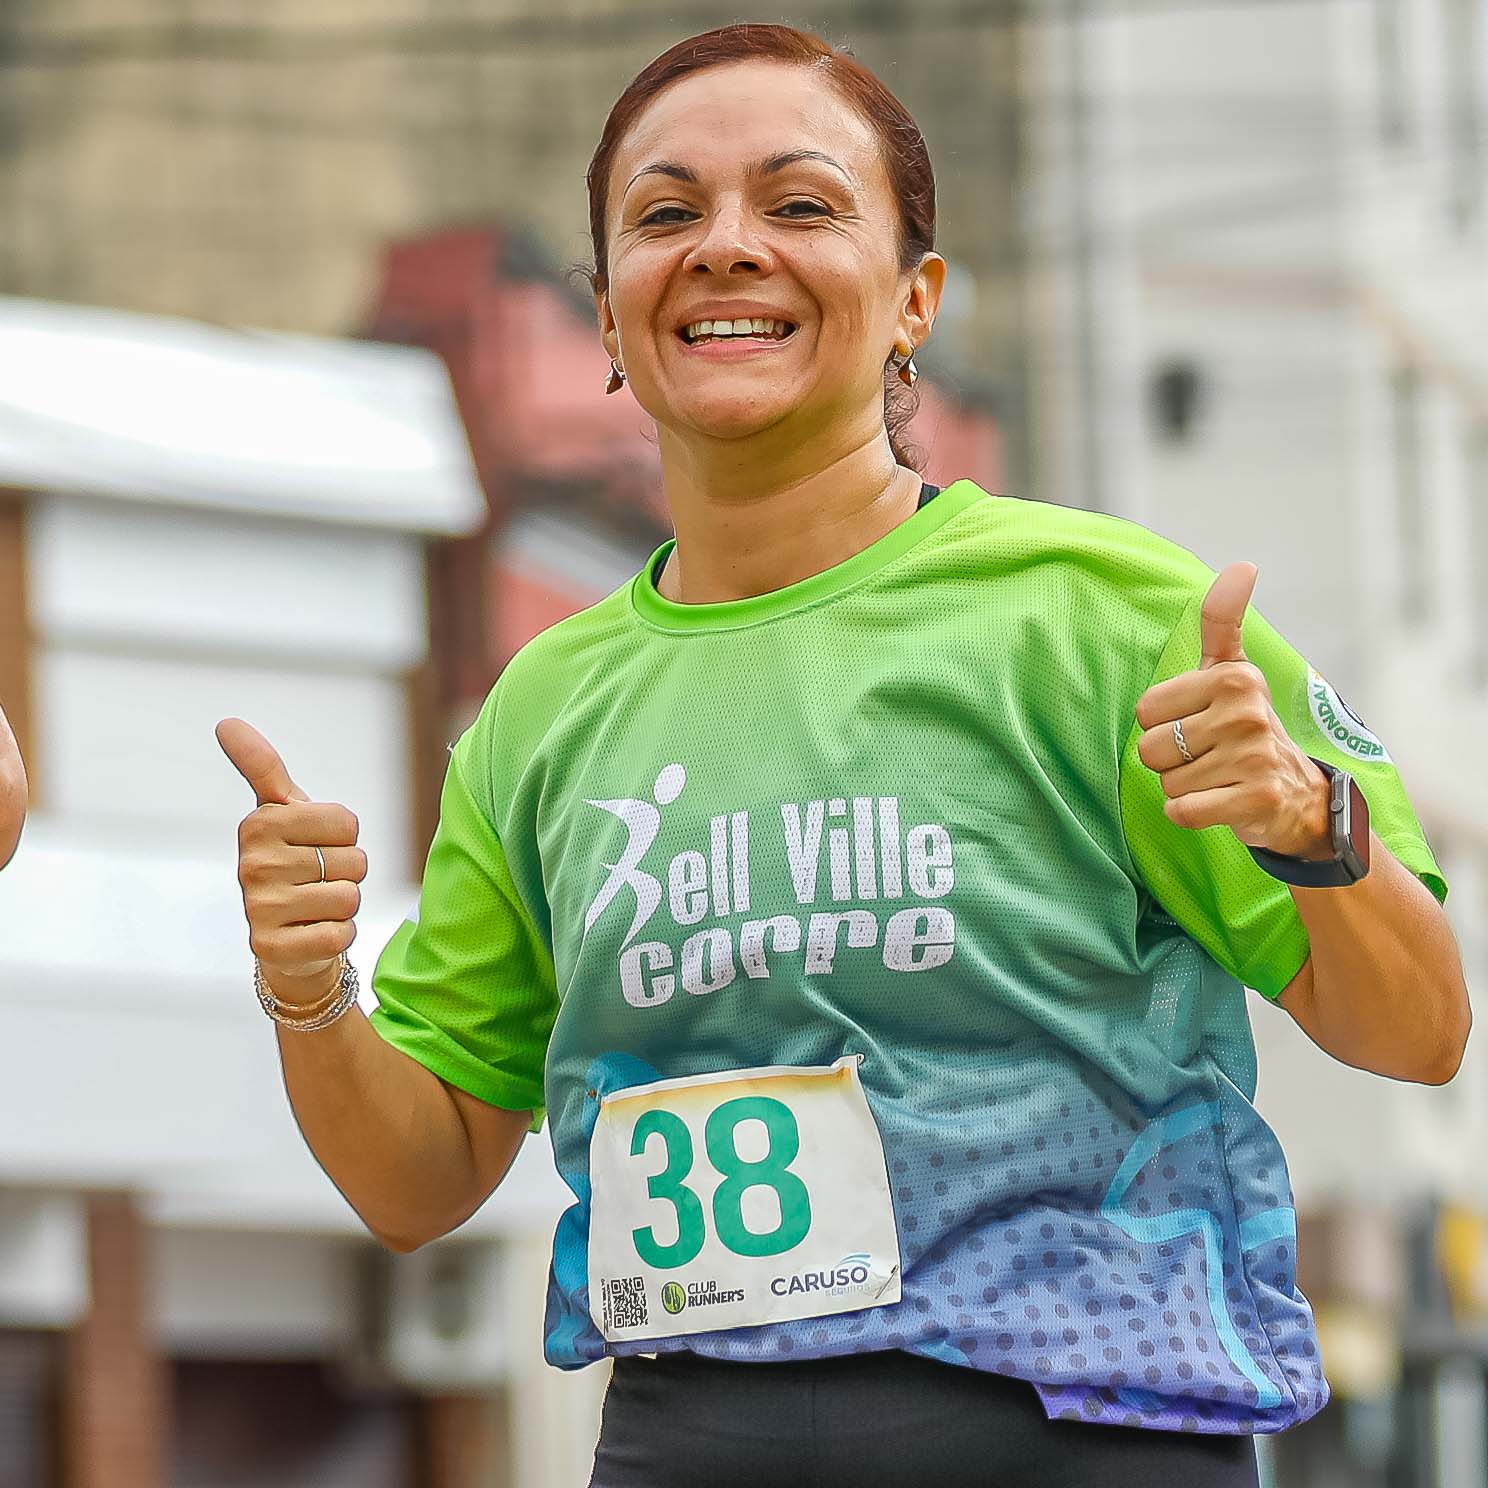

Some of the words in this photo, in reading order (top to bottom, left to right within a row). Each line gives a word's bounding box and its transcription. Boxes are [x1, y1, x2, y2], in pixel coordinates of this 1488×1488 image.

[780, 796, 955, 904] Ville
[630, 1096, 812, 1269] 38
[687, 1280, 717, 1295] CLUB
[770, 1266, 868, 1296] CARUSO
[688, 1288, 745, 1309] RUNNER'S
